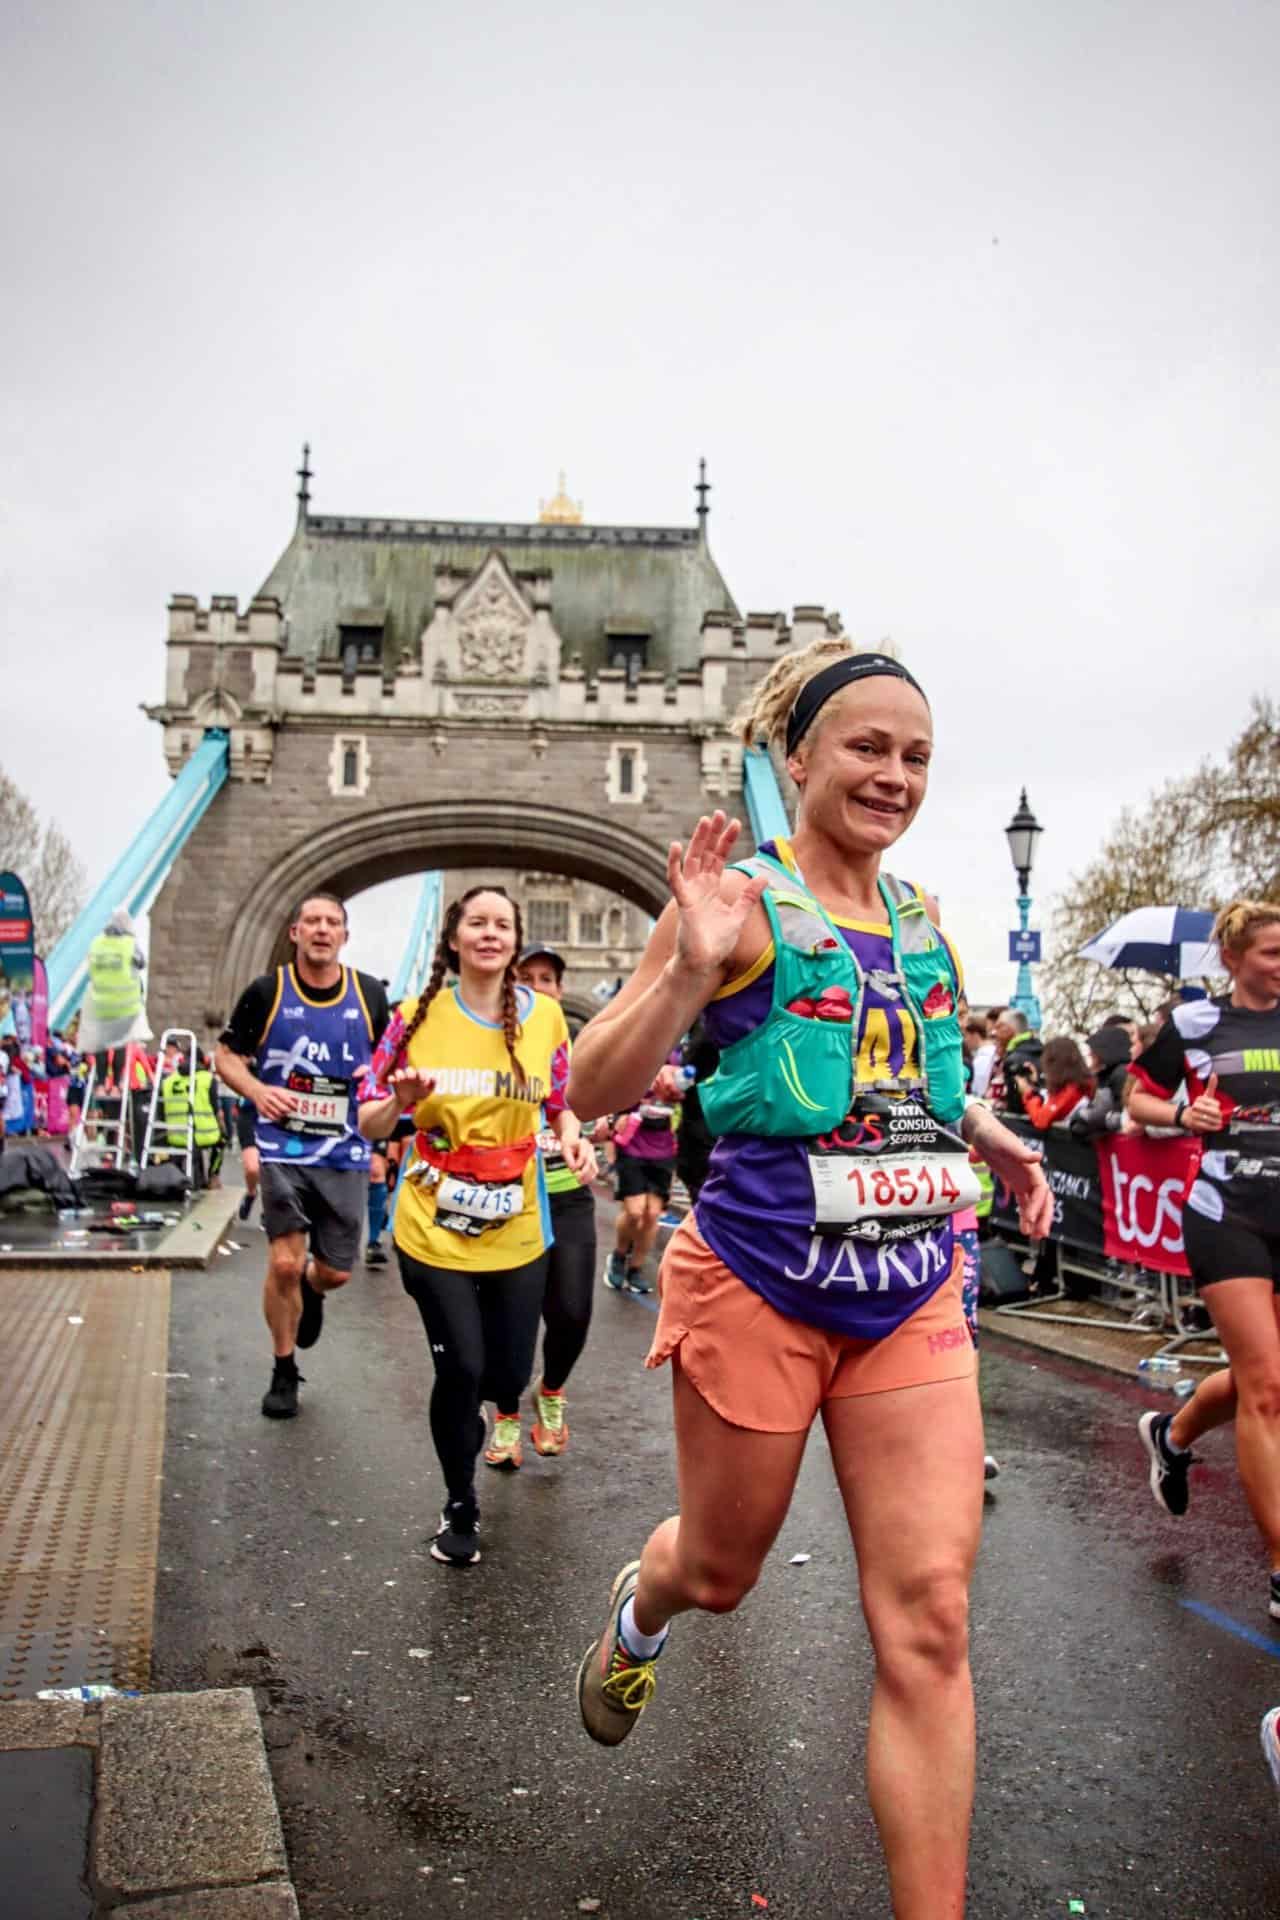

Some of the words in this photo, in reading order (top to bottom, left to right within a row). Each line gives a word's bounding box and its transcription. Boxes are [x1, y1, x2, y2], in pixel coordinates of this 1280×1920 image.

[888, 1105, 924, 1116] TATA
[890, 1132, 937, 1144] SERVICES
[847, 1166, 960, 1207] 18514
[453, 1189, 512, 1213] 47715
[1110, 1152, 1185, 1253] tcs
